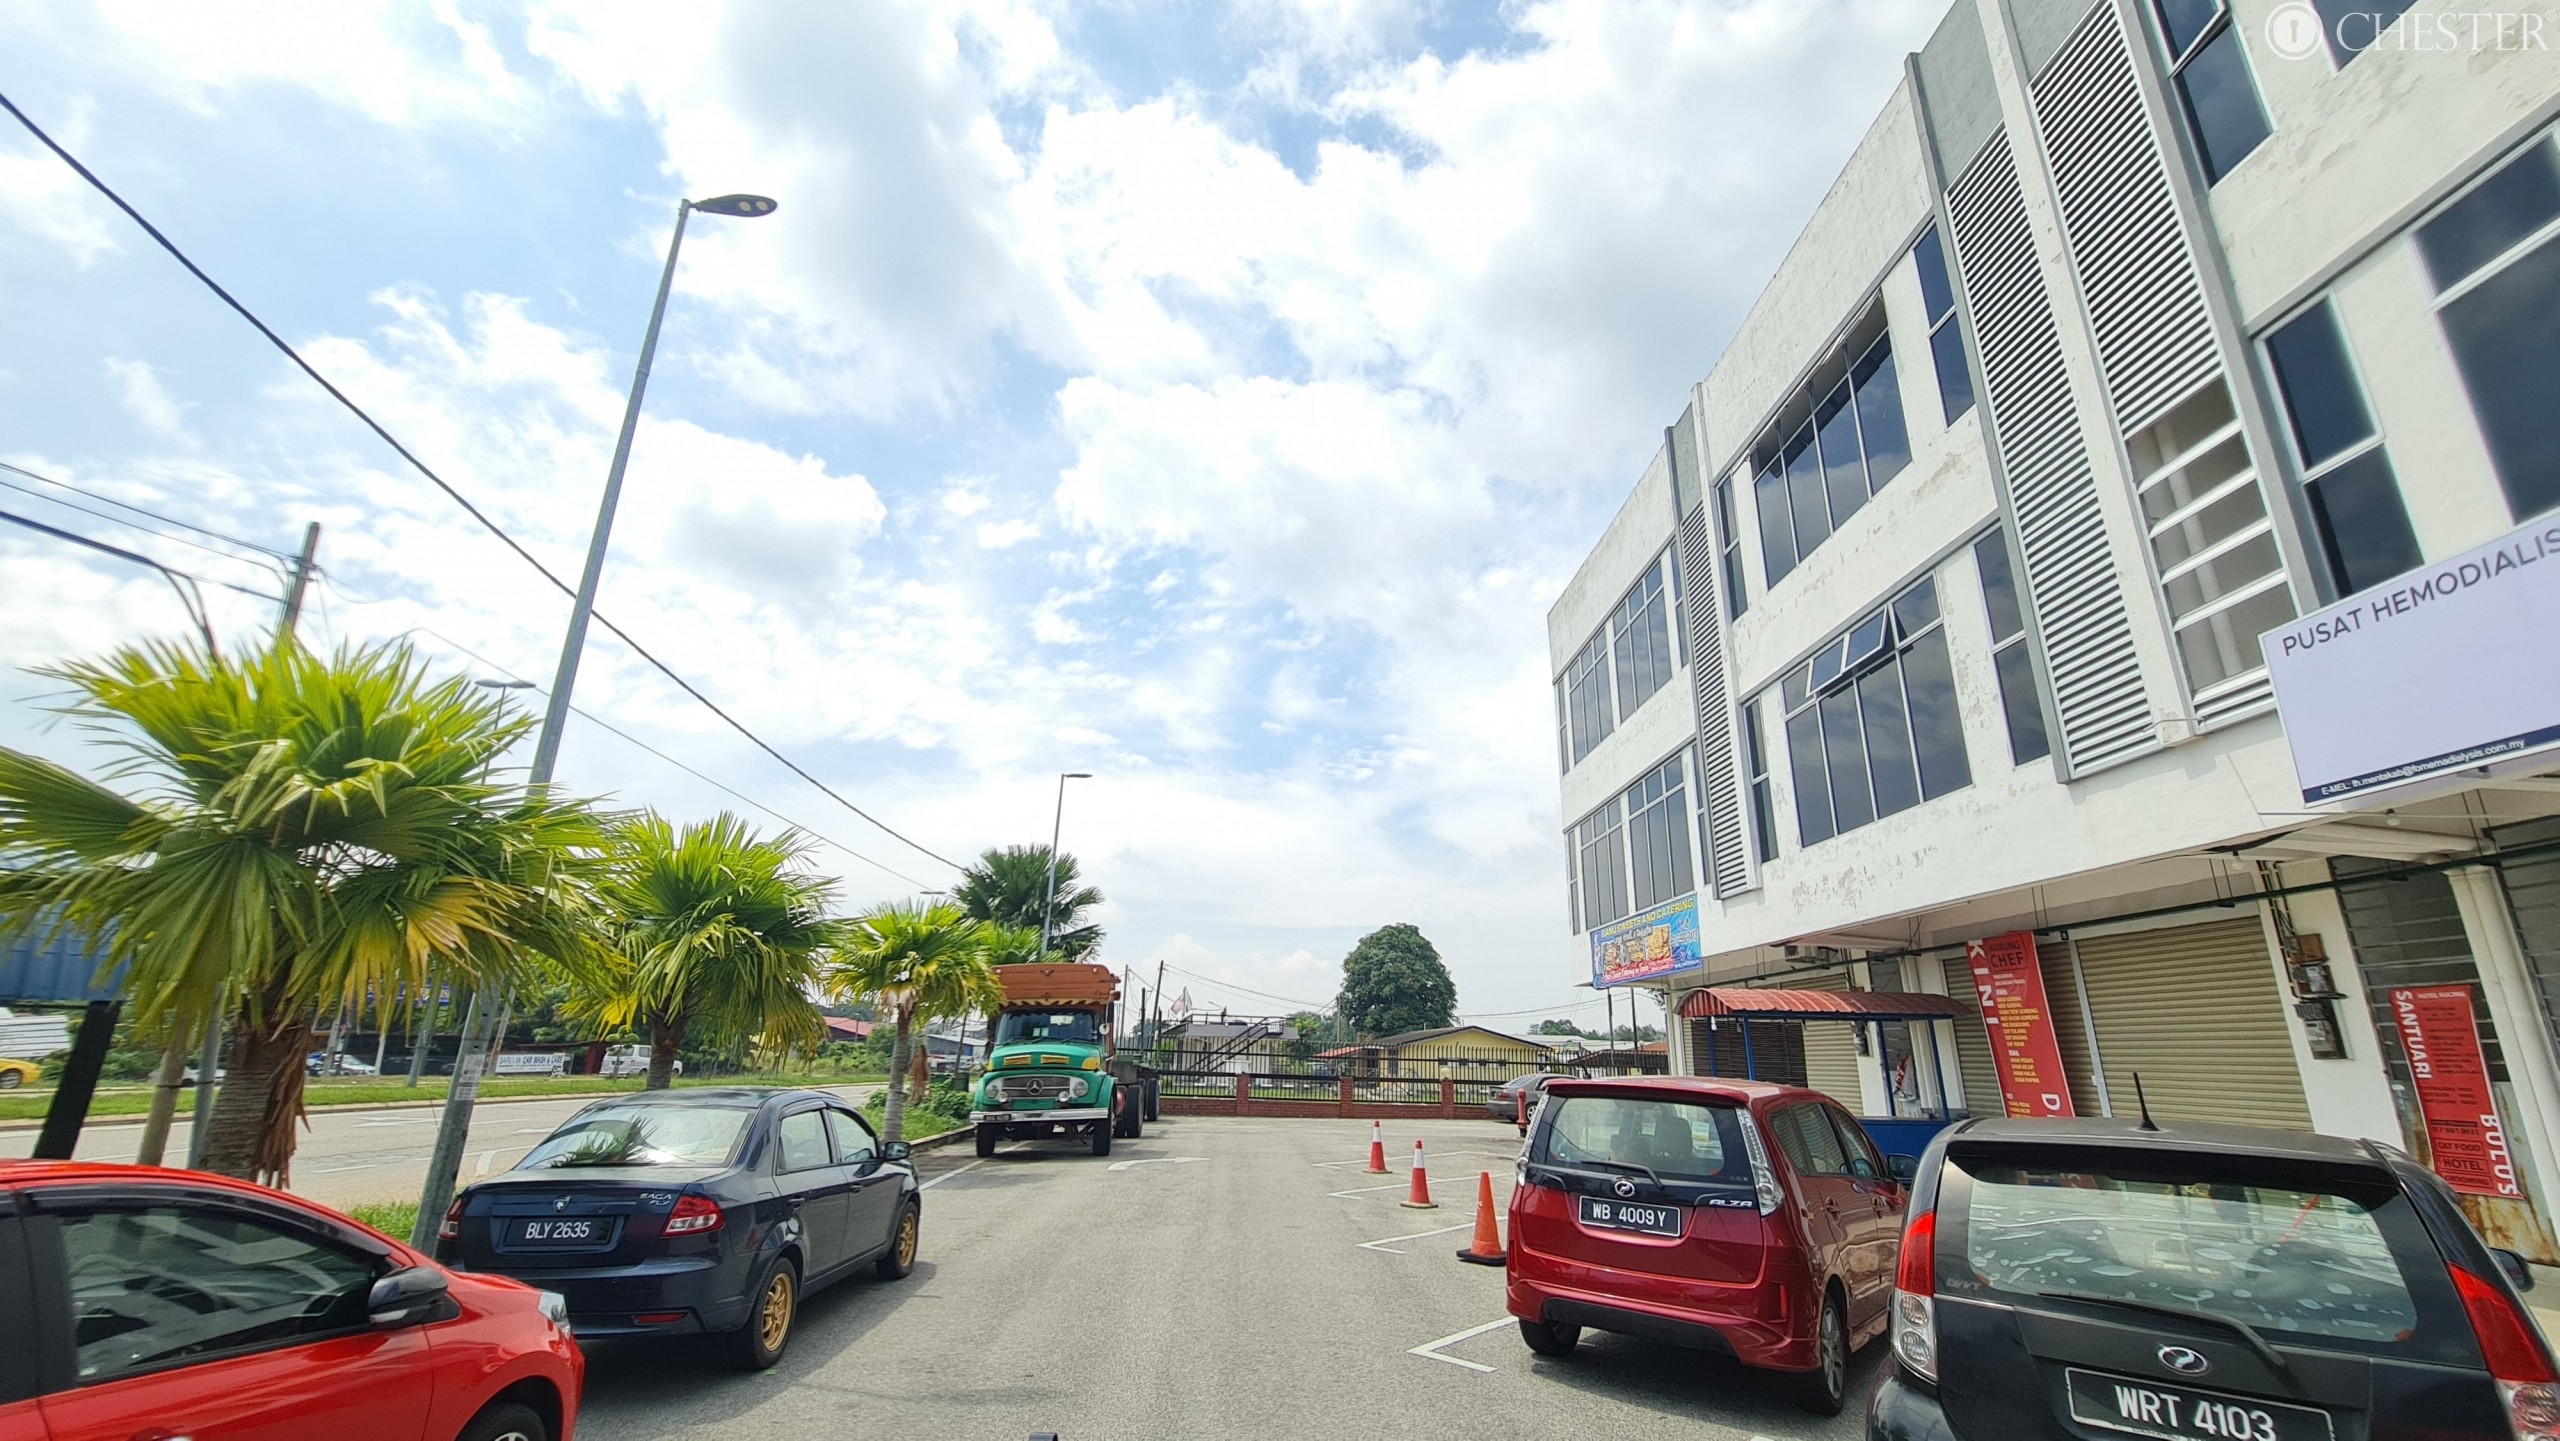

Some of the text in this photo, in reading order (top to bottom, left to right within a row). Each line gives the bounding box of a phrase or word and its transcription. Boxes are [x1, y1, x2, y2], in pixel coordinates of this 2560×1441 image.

[2282, 528, 2560, 656] PUSAT HEMODIALIS
[1616, 918, 1641, 932] SWEETS
[1641, 912, 1656, 923] AND
[1656, 898, 1693, 917] CATERING
[1990, 951, 2024, 968] CHEF
[2396, 991, 2432, 1078] SANTUARI
[2455, 1143, 2481, 1152] FOOD
[2480, 1114, 2518, 1195] BULUS
[2444, 1159, 2485, 1171] HOTEL
[1592, 1202, 1666, 1227] WB 4009 Y
[1709, 1199, 1753, 1207] ALZA
[525, 1221, 591, 1239] BLY 2635
[2114, 1385, 2277, 1441] WRT 4103
